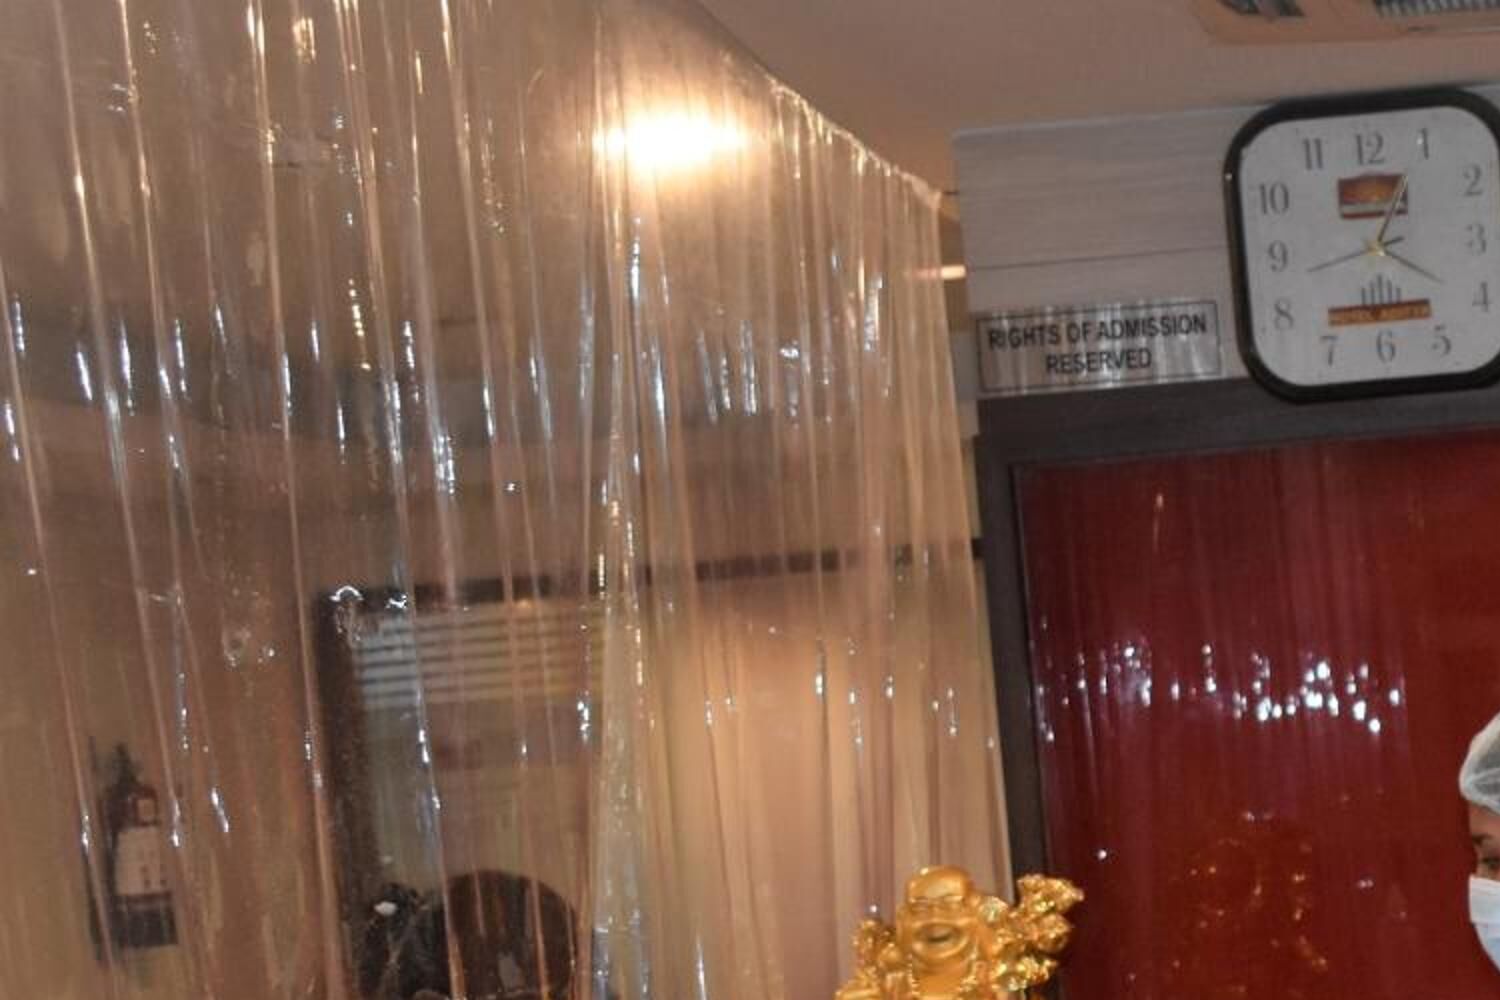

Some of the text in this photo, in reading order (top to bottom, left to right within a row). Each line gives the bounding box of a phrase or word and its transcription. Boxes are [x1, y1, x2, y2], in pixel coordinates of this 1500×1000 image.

[1303, 138, 1323, 170] 11
[1355, 132, 1385, 165] 12
[1417, 128, 1429, 160] 1
[1463, 164, 1483, 196] 2
[1260, 182, 1290, 214] 10
[1466, 223, 1487, 254] 3
[1268, 240, 1288, 272] 9
[1472, 281, 1490, 312] 4
[988, 314, 1208, 349] RIGHTS OF ADMISSION
[1274, 301, 1294, 331] 8
[1320, 335, 1338, 366] 7
[1376, 331, 1396, 362] 6
[1432, 325, 1451, 355] 5
[1046, 348, 1152, 375] RESERVED
